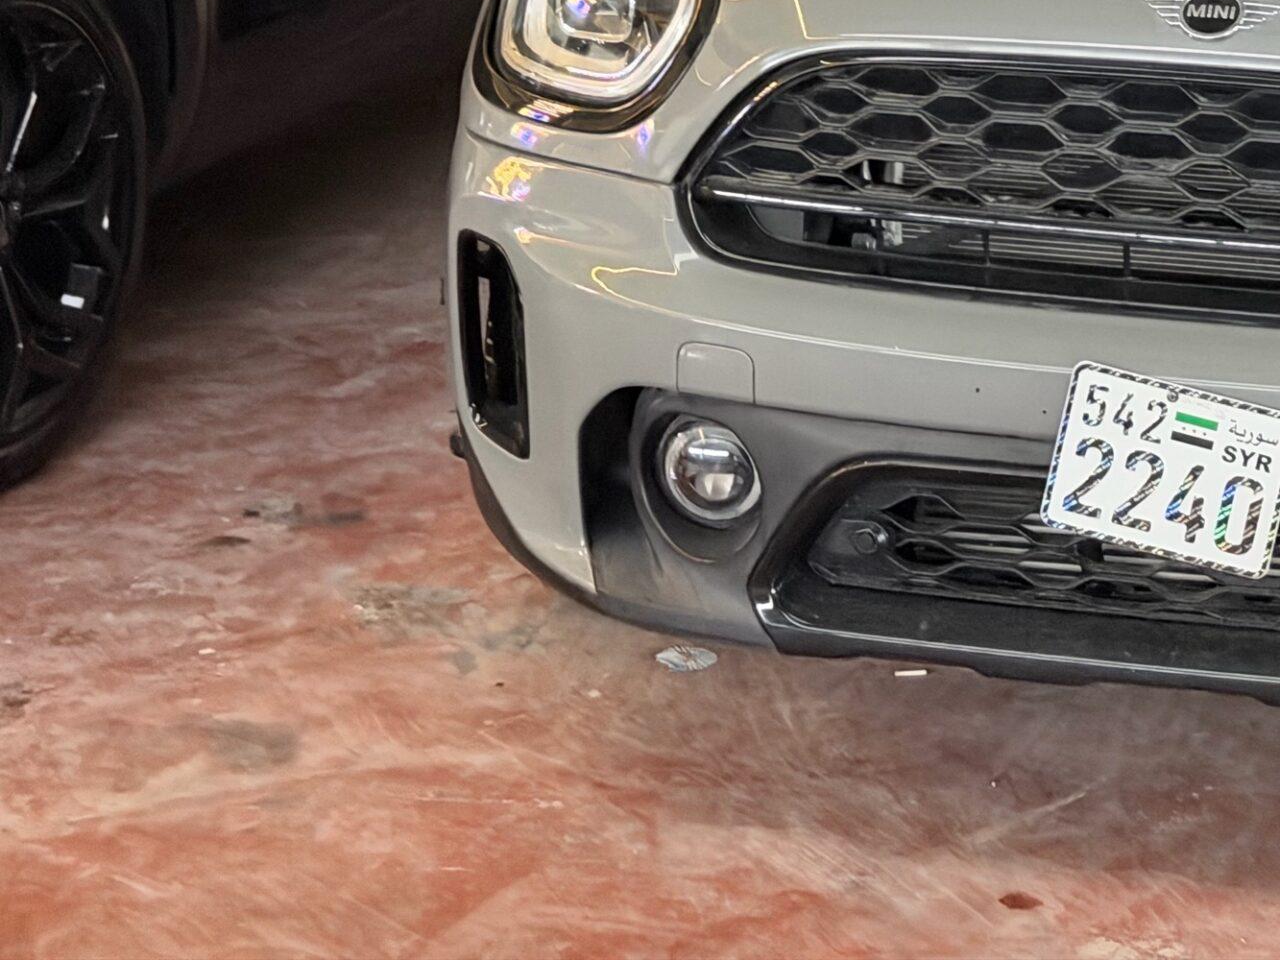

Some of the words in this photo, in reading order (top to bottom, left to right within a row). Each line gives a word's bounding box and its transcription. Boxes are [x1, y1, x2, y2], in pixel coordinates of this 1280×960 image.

[1186, 4, 1237, 20] MINI
[1082, 384, 1168, 444] 542
[1228, 418, 1279, 446] سورية
[1221, 445, 1273, 473] SYR
[1062, 436, 1264, 555] 2240
